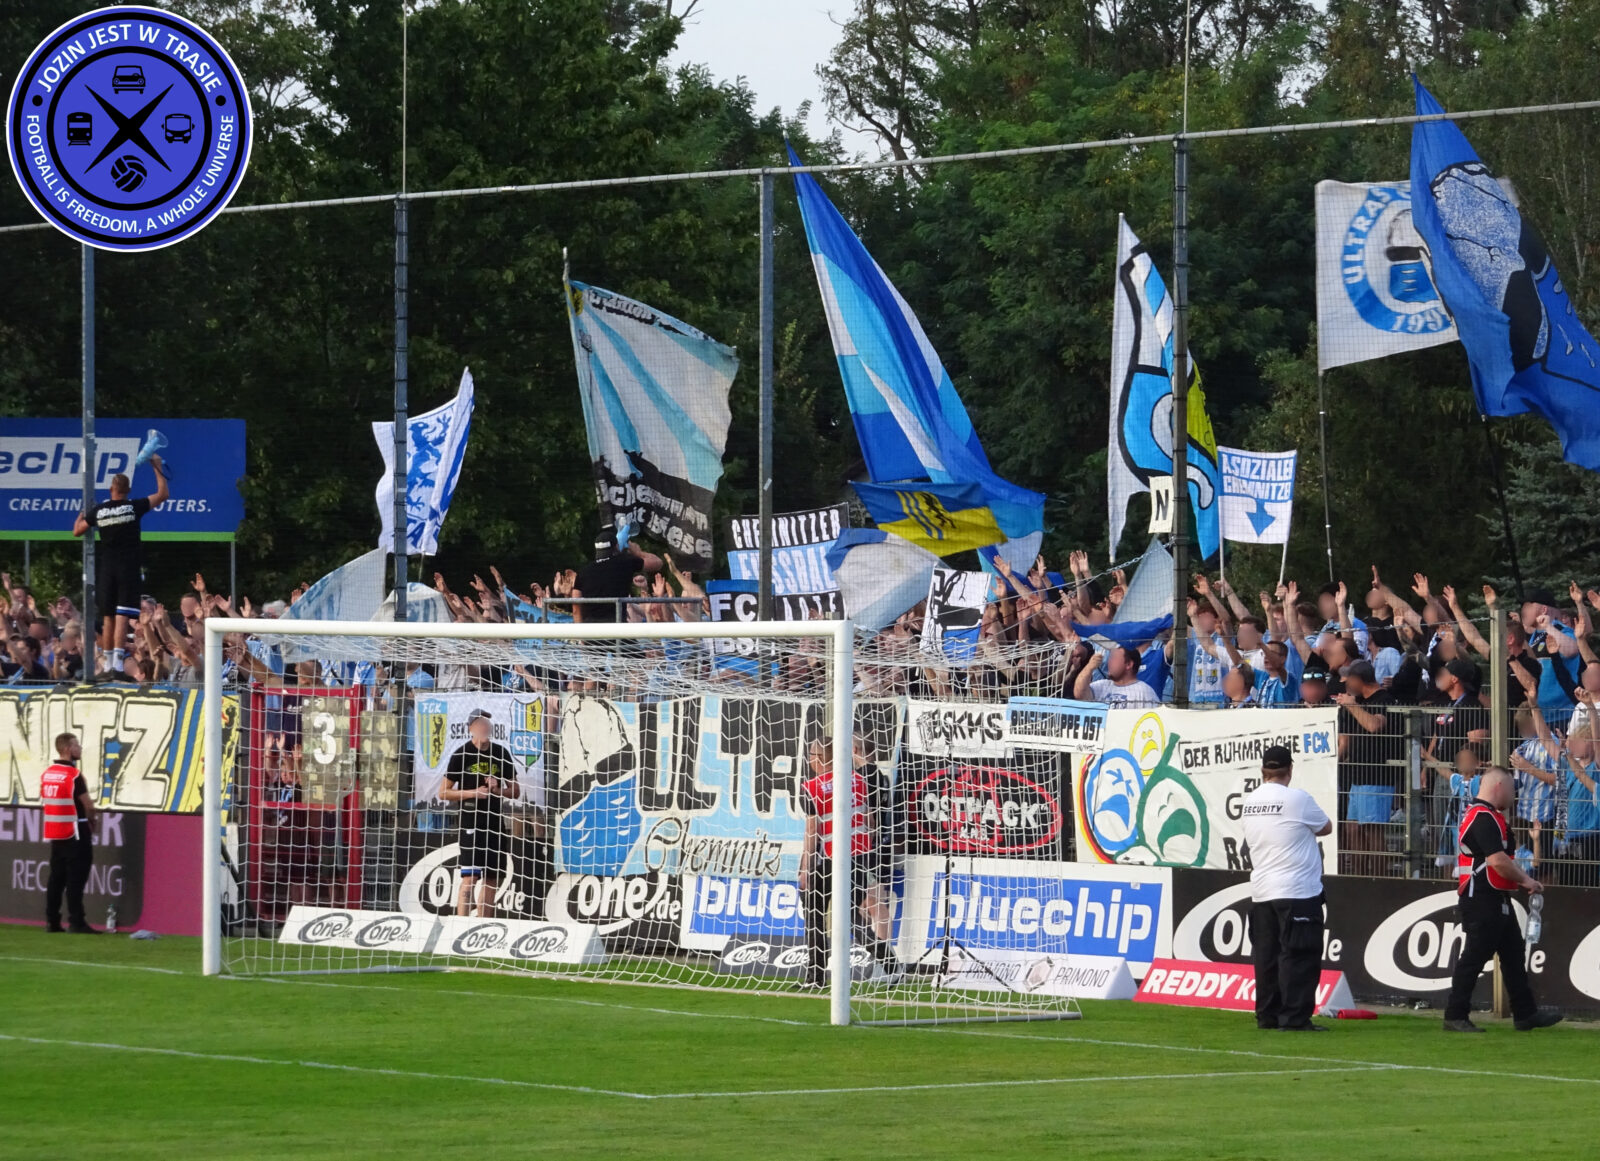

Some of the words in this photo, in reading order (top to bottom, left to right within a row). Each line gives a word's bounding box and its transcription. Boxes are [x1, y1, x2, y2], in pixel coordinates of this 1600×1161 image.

[1344, 187, 1391, 284] ULTRAS
[0, 443, 128, 483] echp
[9, 498, 84, 512] CREATIN
[1156, 488, 1169, 521] N
[731, 509, 841, 549] CHENITZER
[421, 701, 442, 714] FCK
[314, 712, 337, 764] 3
[450, 722, 474, 740] SEKT
[513, 735, 538, 752] CFC
[1082, 715, 1103, 741] OST
[1184, 746, 1210, 769] DER
[1303, 731, 1331, 754] FCK
[1243, 804, 1284, 814] SECURITY
[644, 816, 783, 878] Chemnitz
[12, 859, 123, 896] RECNG
[578, 876, 681, 920] one.de
[699, 877, 805, 921] blue
[312, 921, 353, 938] one.de
[369, 923, 412, 942] one.de
[935, 879, 1152, 954] bluechip
[467, 932, 508, 950] one.de
[525, 935, 568, 953] one.de
[1055, 966, 1110, 988] PRIMONO
[1142, 969, 1238, 999] REDDY
